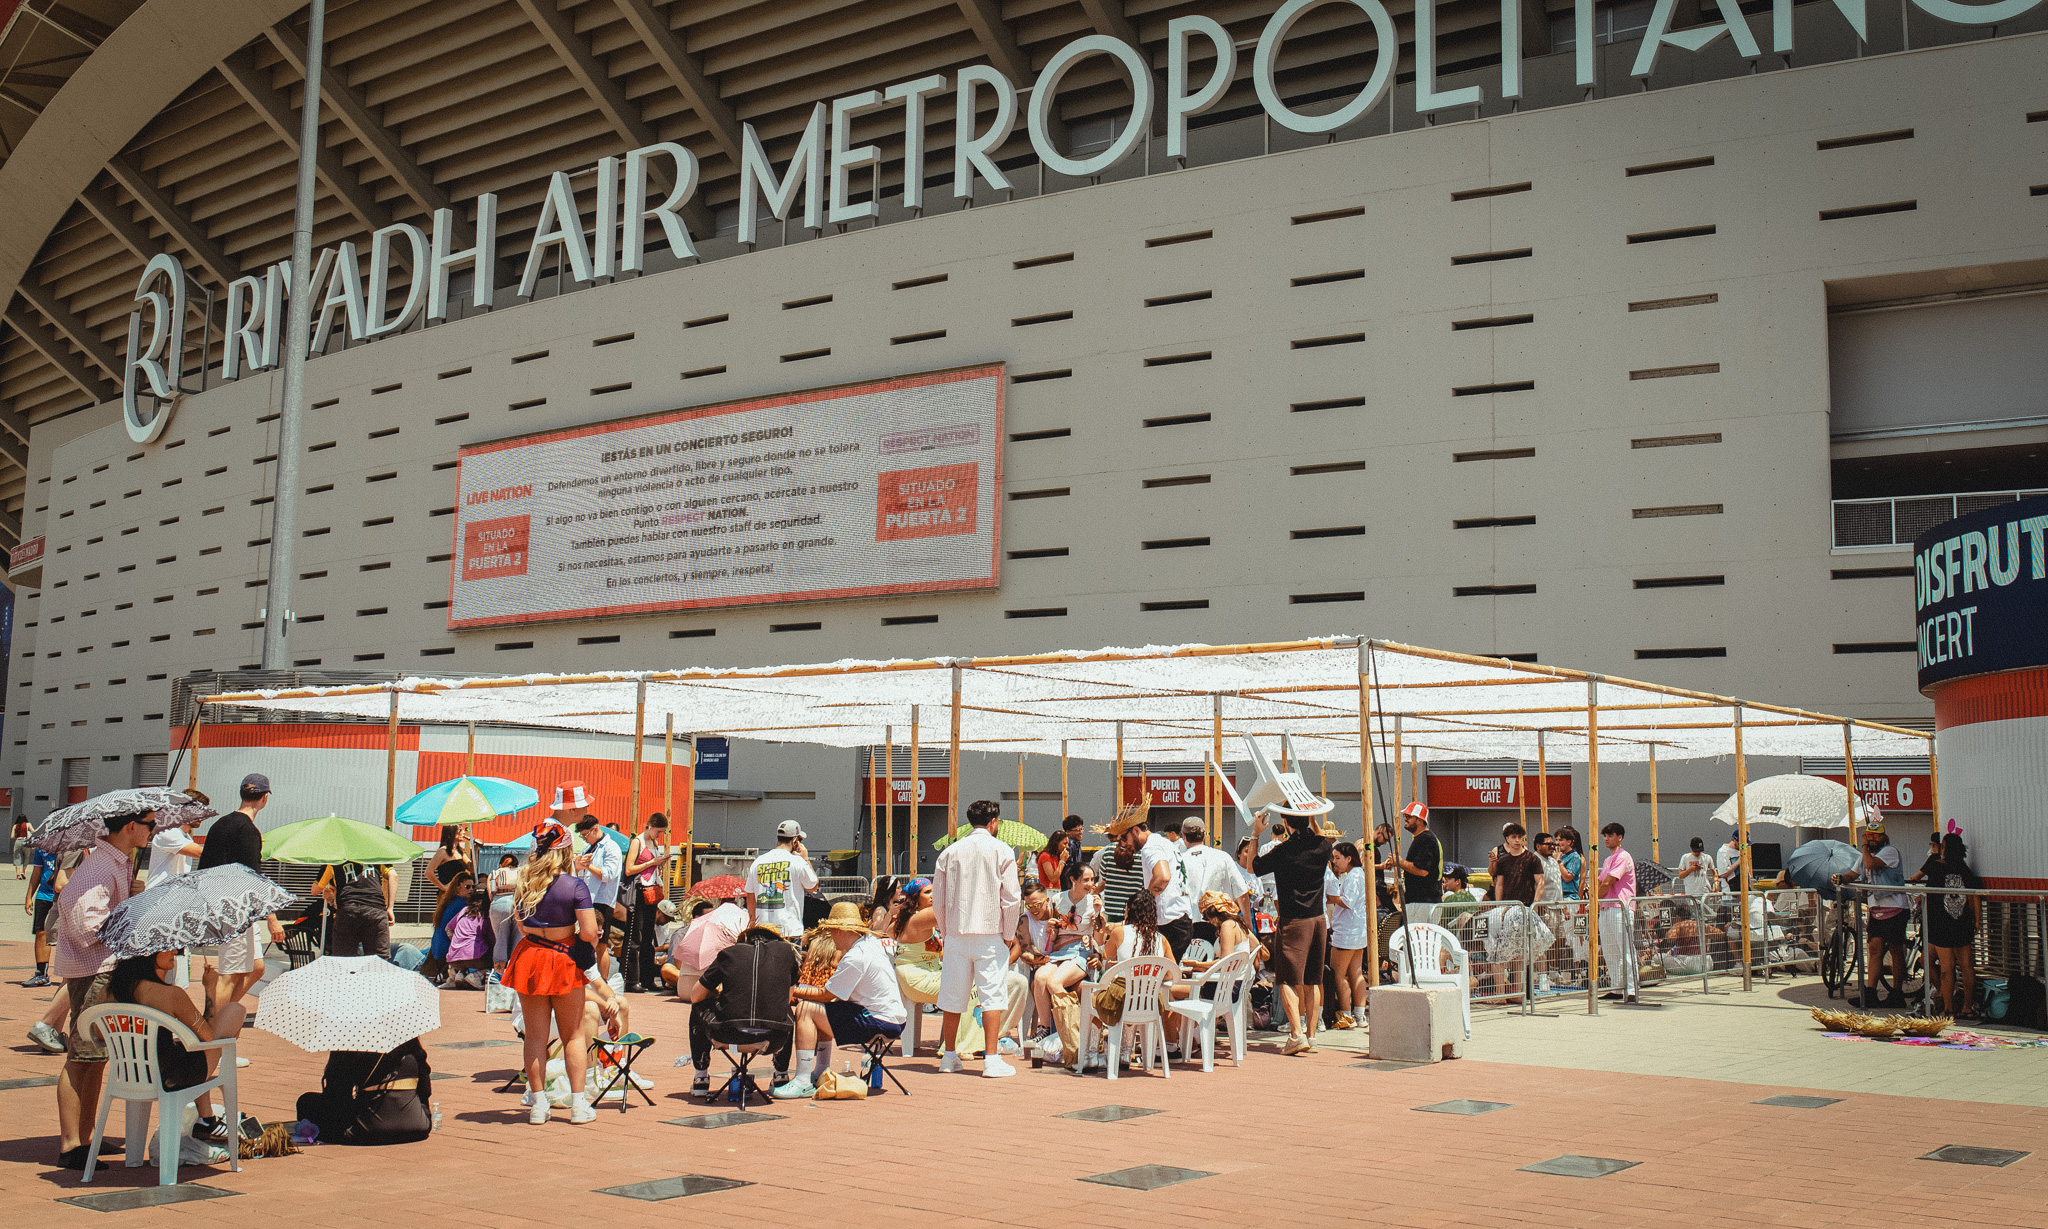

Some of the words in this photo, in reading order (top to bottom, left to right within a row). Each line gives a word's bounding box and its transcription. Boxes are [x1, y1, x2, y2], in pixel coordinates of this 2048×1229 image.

[222, 193, 498, 380] RIYADH
[518, 141, 700, 297] AIR
[737, 0, 2044, 245] METROPOLITA
[602, 449, 636, 463] ¡ESTÁS
[639, 446, 653, 458] EN
[656, 443, 671, 455] UN
[673, 434, 738, 453] CONCIERTO
[741, 426, 793, 443] SEGURO!
[548, 477, 598, 491] Defendemos
[600, 475, 611, 483] un
[614, 470, 647, 482] entorno
[650, 463, 693, 476] divertido,
[695, 460, 716, 470] libre
[720, 460, 725, 470] y
[728, 455, 761, 468] seguro
[763, 450, 796, 462] donde
[799, 449, 811, 458] no
[814, 447, 825, 456] se
[828, 442, 860, 454] tolera
[467, 491, 488, 505] LIVE
[490, 484, 532, 502] NATION
[598, 485, 632, 499] ninguna
[635, 480, 674, 493] violencia
[676, 479, 682, 487] o
[684, 475, 705, 486] acto
[708, 472, 720, 483] de
[722, 467, 767, 481] cualquier
[899, 478, 956, 495] SITUADO
[546, 515, 553, 526] Si
[555, 514, 573, 525] algo
[575, 513, 585, 522] no
[587, 512, 597, 521] va
[600, 508, 618, 519] bien
[620, 504, 654, 516] contigo
[656, 504, 662, 512] o
[664, 502, 681, 511] con
[683, 496, 718, 509] alguien
[720, 492, 761, 504] cercano,
[764, 486, 807, 500] acércate
[810, 486, 816, 494] a
[819, 481, 859, 494] nuestro
[907, 496, 924, 508] EN
[928, 493, 945, 506] LA
[633, 518, 659, 529] Punto
[661, 512, 706, 525] RESPECT
[708, 507, 748, 520] NATION.
[885, 509, 952, 529] PUERTA
[956, 506, 967, 522] 2
[478, 528, 515, 542] SITUADO
[571, 537, 605, 550] También
[607, 534, 640, 547] puedes
[641, 530, 670, 543] hablar
[672, 529, 688, 538] con
[691, 524, 727, 537] nuestro
[729, 519, 751, 533] staff
[754, 519, 766, 531] de
[769, 513, 822, 529] seguridad.
[483, 542, 495, 553] EN
[497, 541, 508, 551] LA
[557, 561, 565, 572] Si
[567, 561, 582, 571] nos
[583, 557, 625, 569] necesitas,
[627, 552, 665, 564] estamos
[666, 551, 687, 562] para
[689, 546, 732, 559] ayudarte
[734, 545, 740, 553] a
[743, 540, 779, 555] pasarlo
[782, 540, 794, 549] en
[797, 536, 837, 549] grande.
[469, 553, 512, 570] PUERTA
[514, 552, 521, 566] 2
[1916, 515, 2048, 612] DISFRUT
[606, 577, 617, 588] En
[619, 576, 631, 586] los
[633, 572, 680, 585] conciertos,
[683, 573, 688, 582] y
[690, 568, 729, 580] siempre,
[732, 563, 774, 577] ¡respeta!
[1917, 606, 1977, 672] NCERT
[892, 780, 911, 791] UERTA
[917, 779, 926, 802] 9
[897, 791, 911, 802] GATE
[1151, 779, 1180, 790] PUERTA
[1184, 778, 1196, 803] 8
[1162, 791, 1180, 802] GATE
[1466, 777, 1501, 790] PUERTA
[1505, 777, 1517, 803] 7
[1480, 791, 1501, 803] GATE
[1854, 778, 1889, 791] UERTA
[1896, 777, 1914, 807] 6
[1865, 792, 1890, 806] GATE
[107, 1017, 143, 1026] KFC
